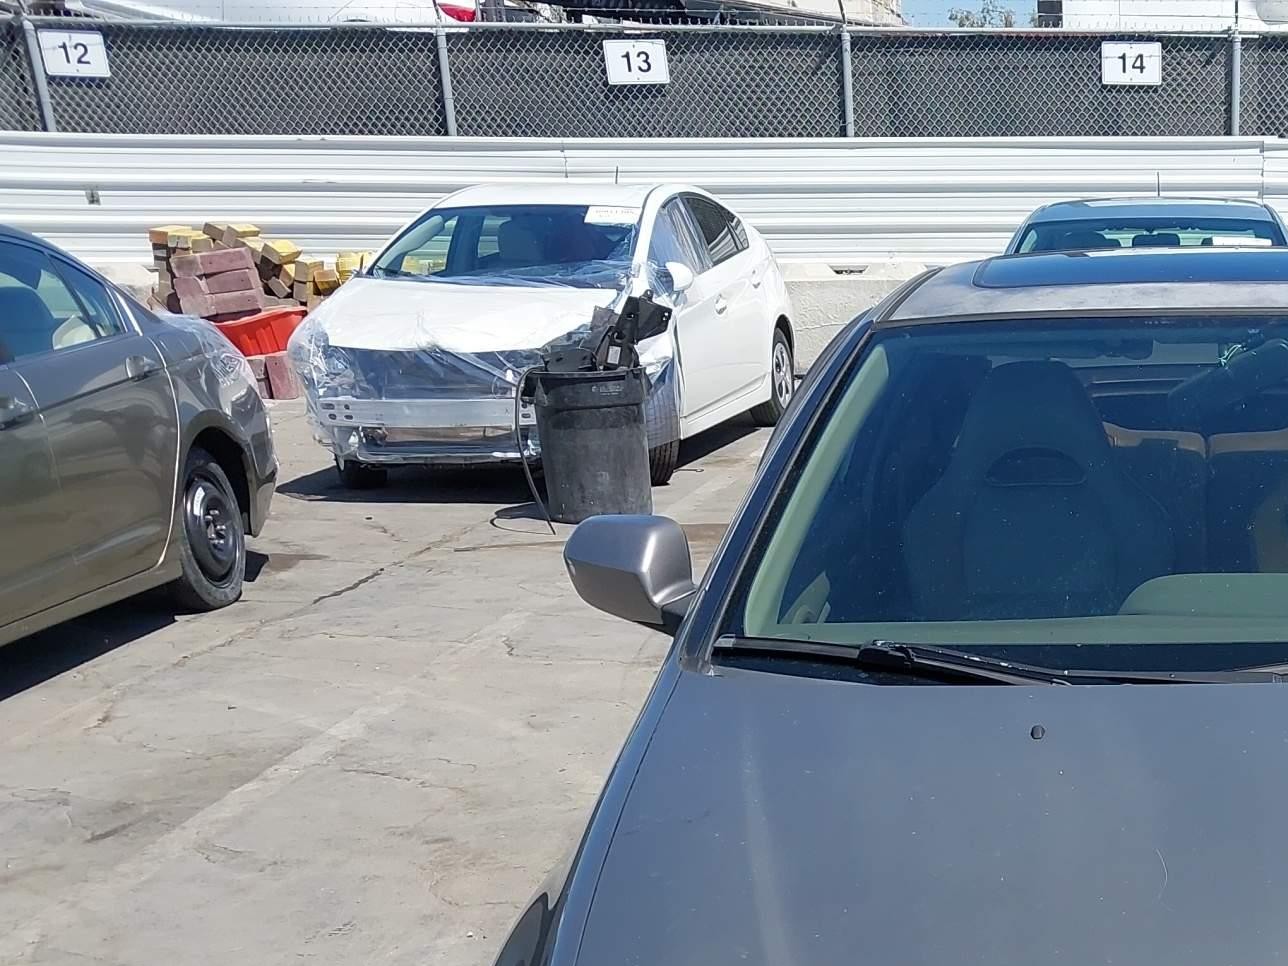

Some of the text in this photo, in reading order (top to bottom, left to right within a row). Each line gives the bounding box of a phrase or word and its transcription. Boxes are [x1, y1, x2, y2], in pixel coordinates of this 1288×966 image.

[58, 42, 91, 65] 12
[621, 51, 652, 73] 13
[1118, 52, 1146, 74] 14
